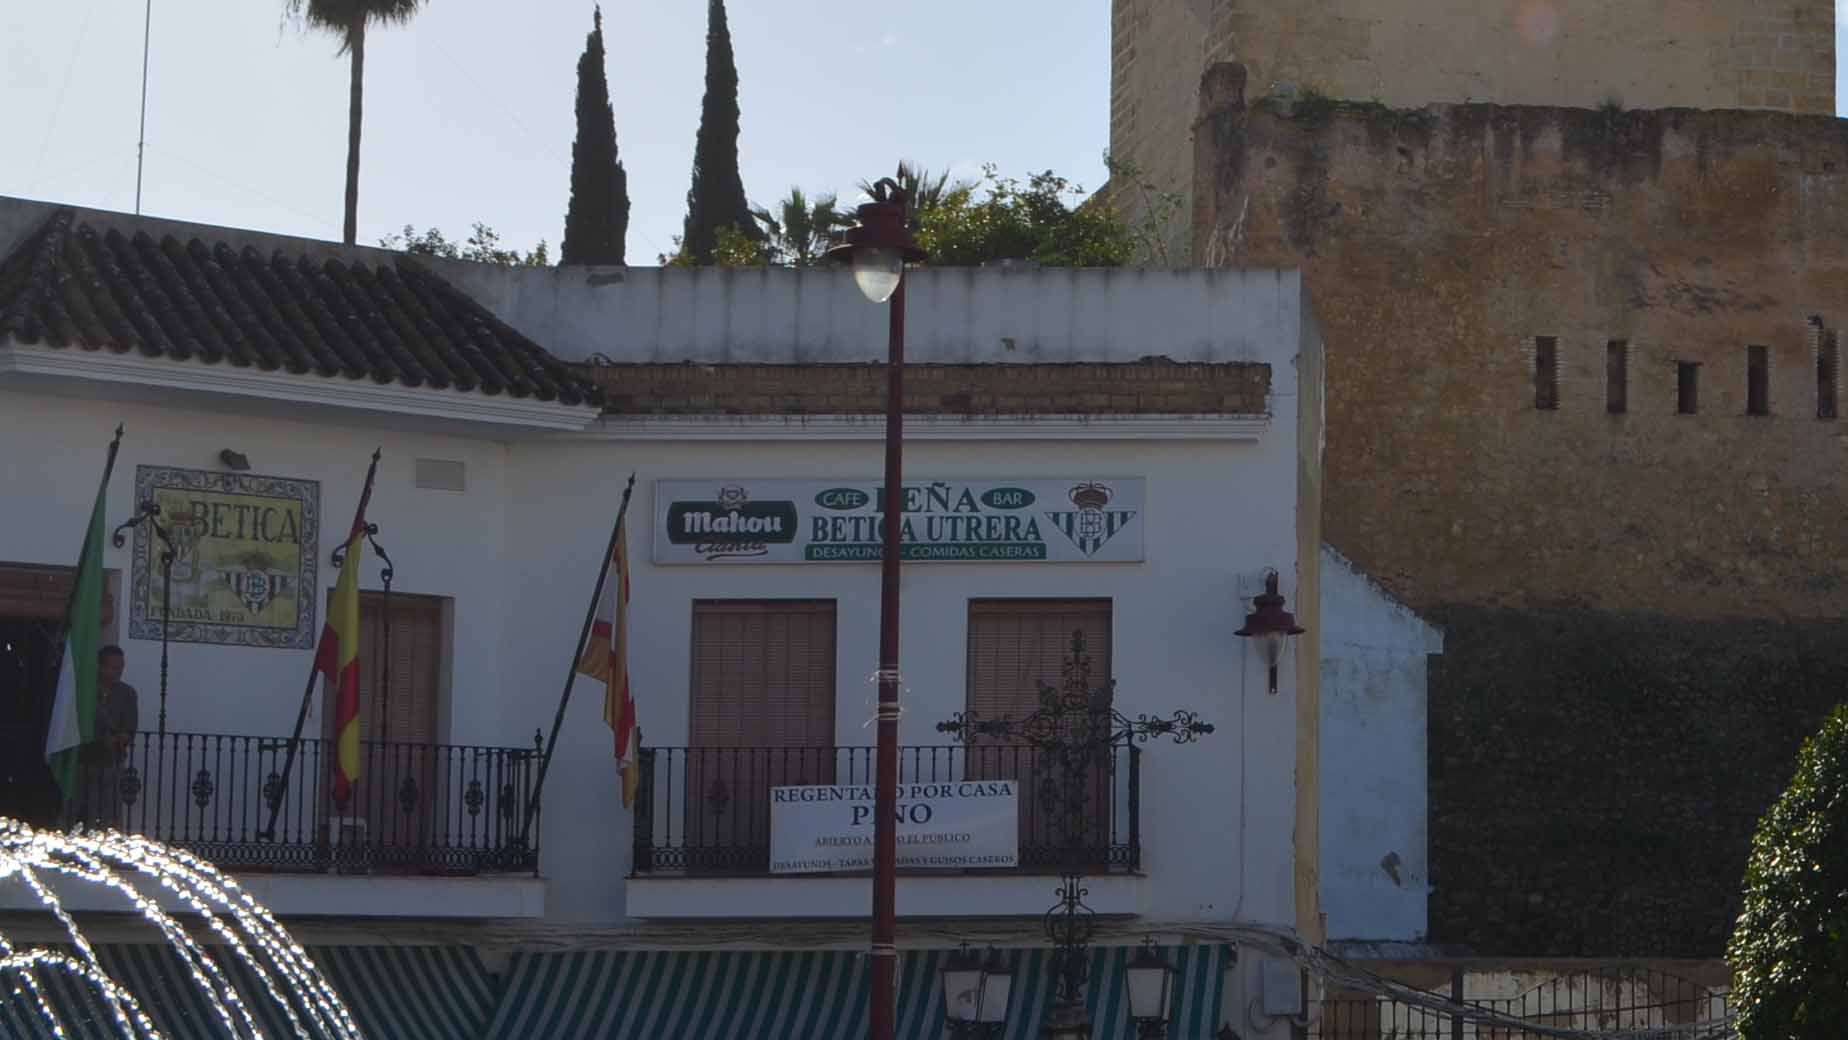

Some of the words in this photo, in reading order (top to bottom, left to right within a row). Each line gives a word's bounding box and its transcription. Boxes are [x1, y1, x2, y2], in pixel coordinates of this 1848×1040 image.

[992, 491, 1023, 505] BAR
[683, 511, 783, 534] Mahou
[926, 516, 1042, 542] UTRERA
[911, 547, 977, 559] COMIDAS
[979, 547, 1040, 558] CASERAS
[774, 786, 905, 802] REGENTAO
[911, 784, 954, 799] POR
[958, 783, 1012, 798] CASA
[850, 803, 933, 826] PNO
